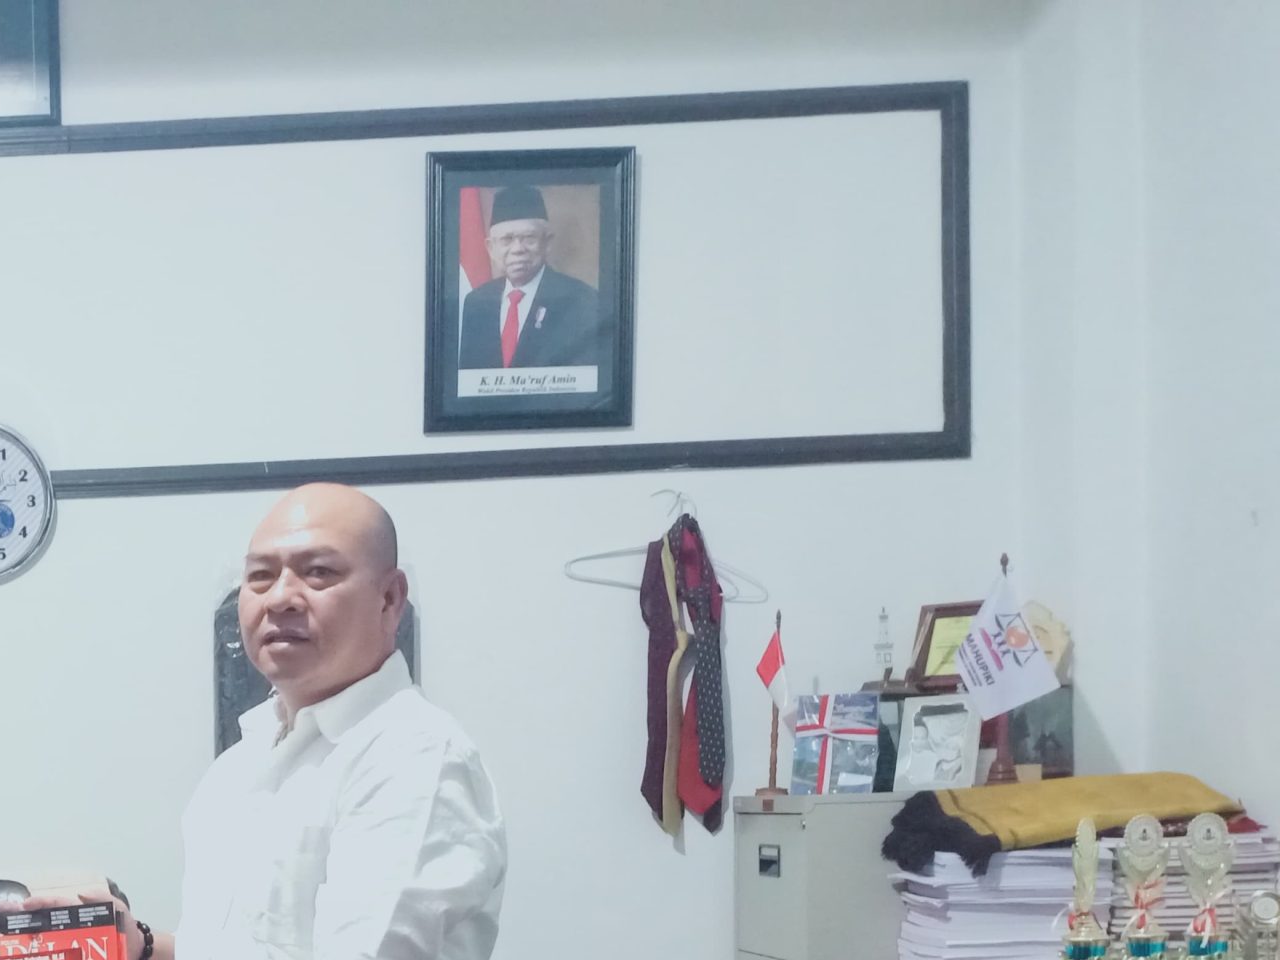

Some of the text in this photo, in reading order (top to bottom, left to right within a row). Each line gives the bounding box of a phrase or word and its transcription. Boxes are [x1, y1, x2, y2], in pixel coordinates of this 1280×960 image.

[550, 373, 577, 384] Amin
[0, 448, 7, 461] 1
[18, 469, 28, 482] 2
[26, 495, 36, 507] 3
[18, 526, 28, 538] 4
[966, 633, 995, 686] MAHUPIKI
